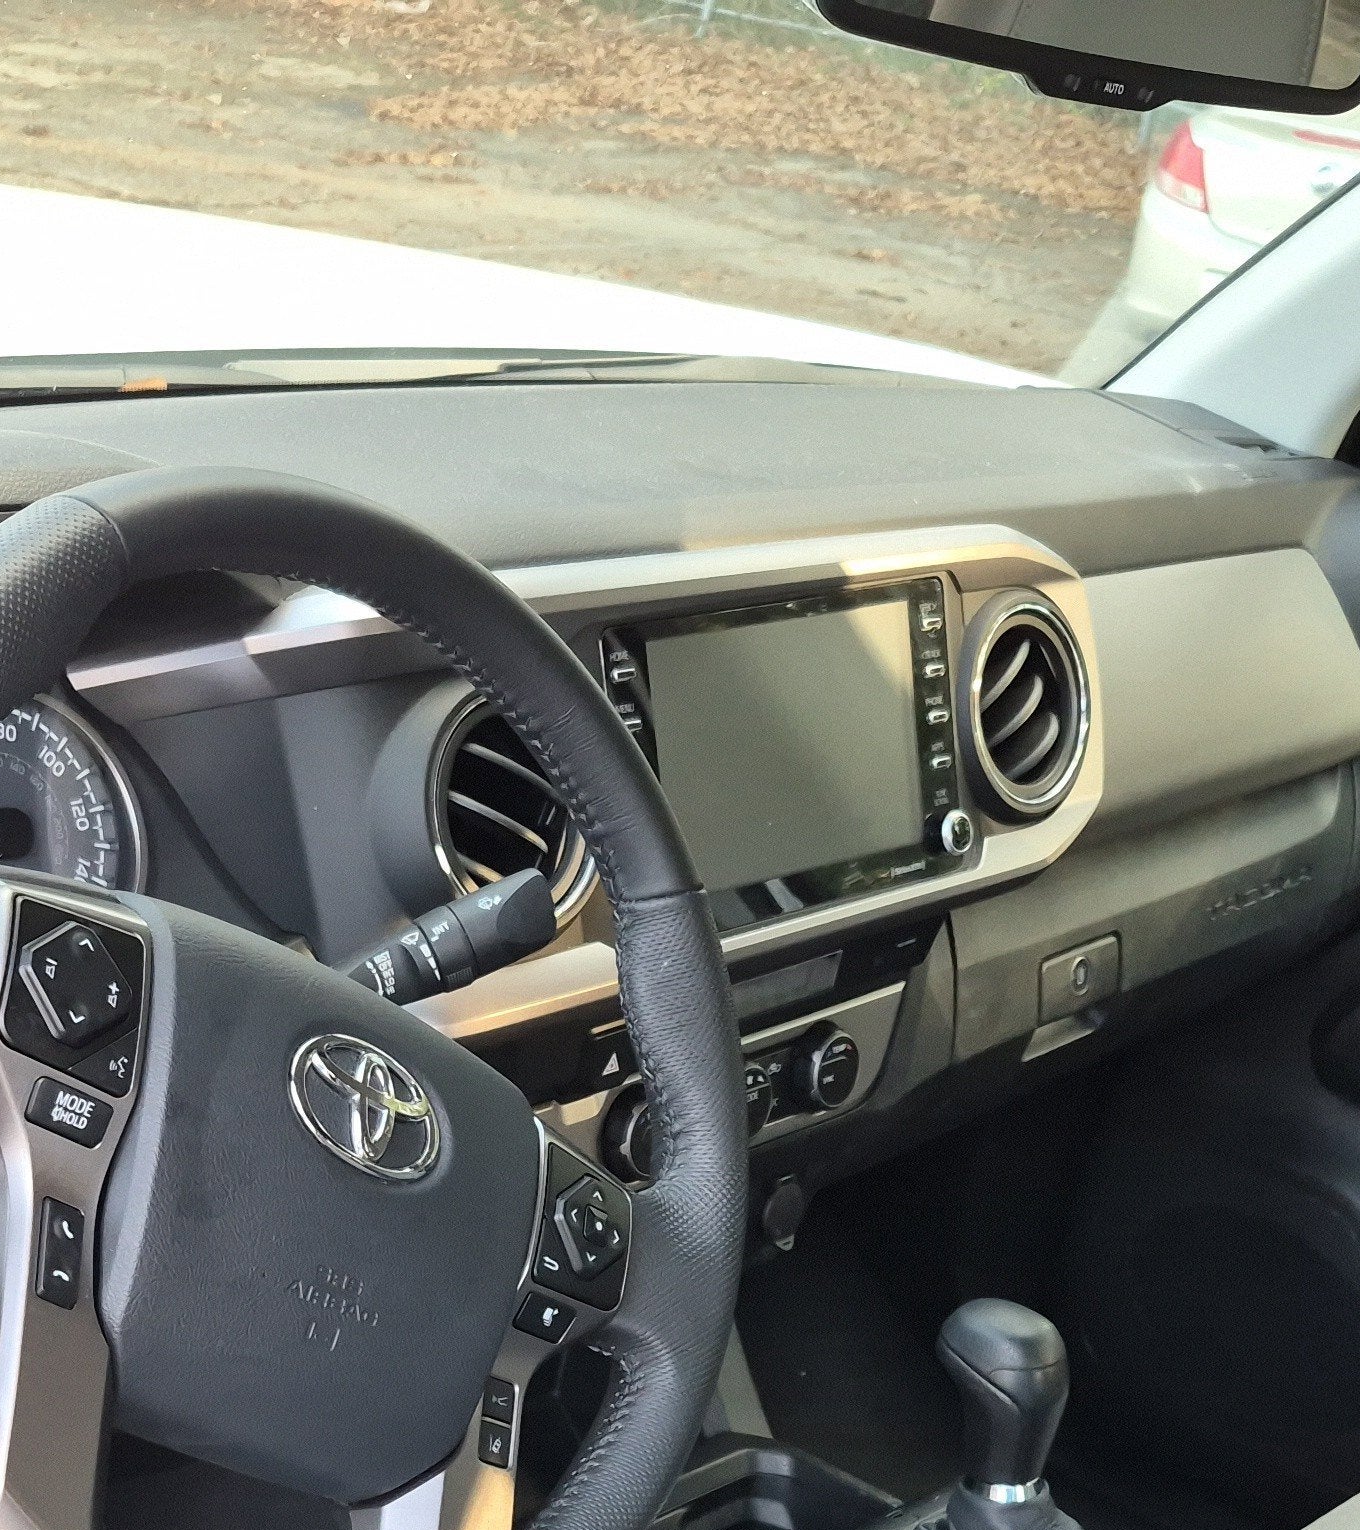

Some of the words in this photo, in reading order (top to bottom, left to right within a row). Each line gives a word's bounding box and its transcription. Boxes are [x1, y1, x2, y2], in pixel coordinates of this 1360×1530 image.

[1103, 81, 1125, 95] AUTO
[39, 745, 66, 777] 100
[70, 798, 90, 831] 120
[55, 1090, 96, 1118] MODE
[62, 1110, 88, 1130] HOLD
